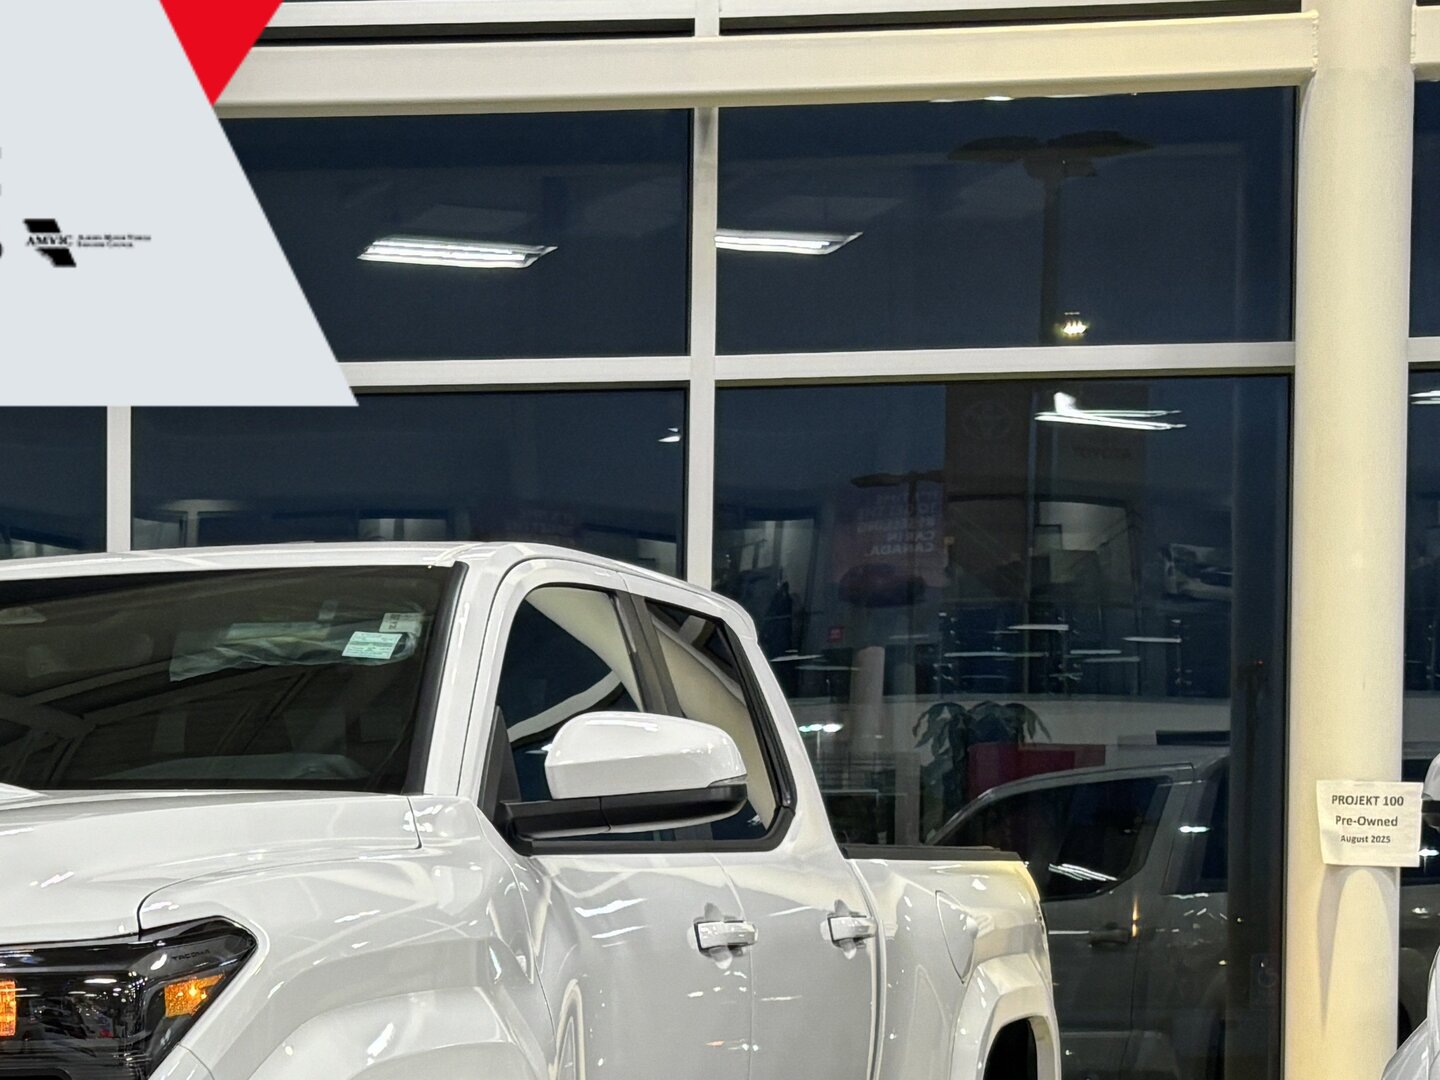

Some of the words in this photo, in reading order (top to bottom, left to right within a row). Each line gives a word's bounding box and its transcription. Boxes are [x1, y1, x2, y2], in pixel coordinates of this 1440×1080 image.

[1331, 795, 1380, 806] PROJEKT
[1383, 796, 1404, 806] 100
[1335, 815, 1398, 827] Pre-Owned
[1340, 835, 1369, 844] August
[1371, 835, 1391, 844] 2025
